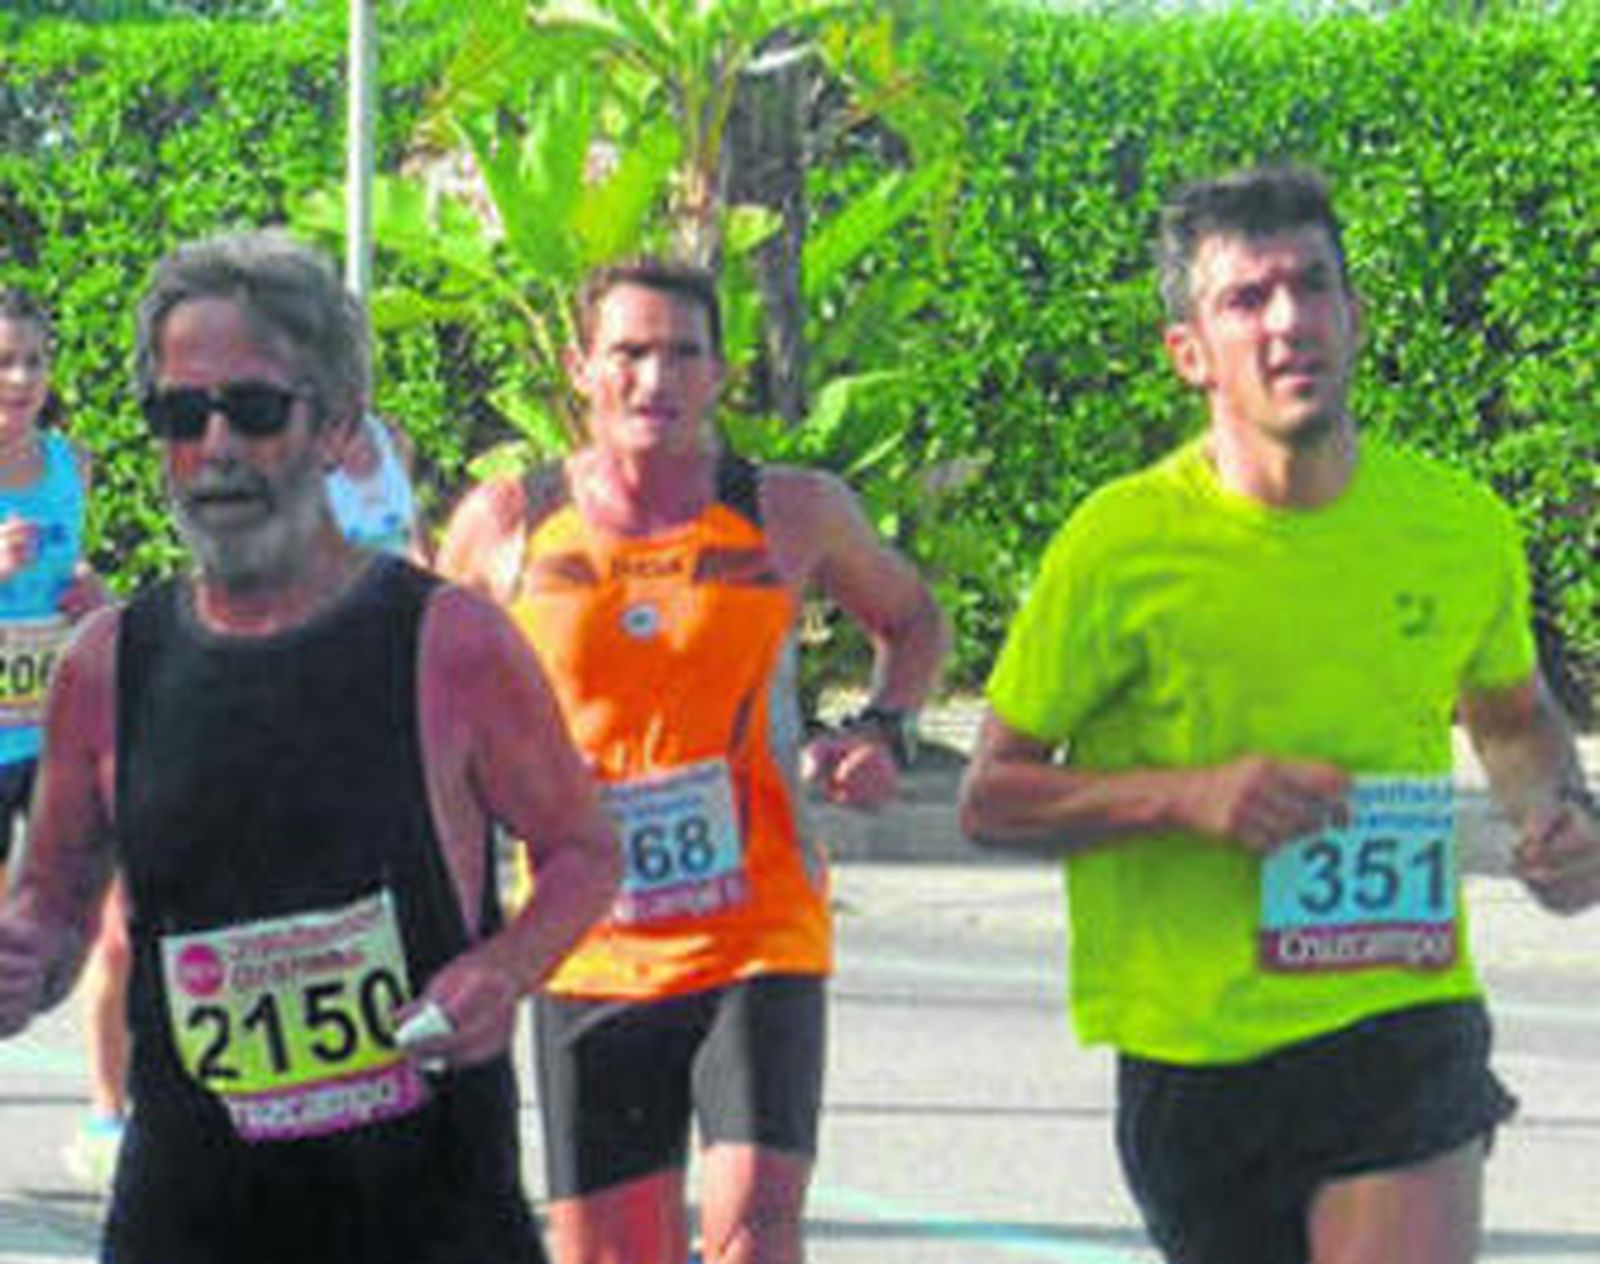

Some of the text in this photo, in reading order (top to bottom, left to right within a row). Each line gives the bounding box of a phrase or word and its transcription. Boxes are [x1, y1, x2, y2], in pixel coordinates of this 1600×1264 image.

[631, 817, 715, 884] 68
[1299, 840, 1445, 915] 351
[186, 967, 404, 1080] 2150
